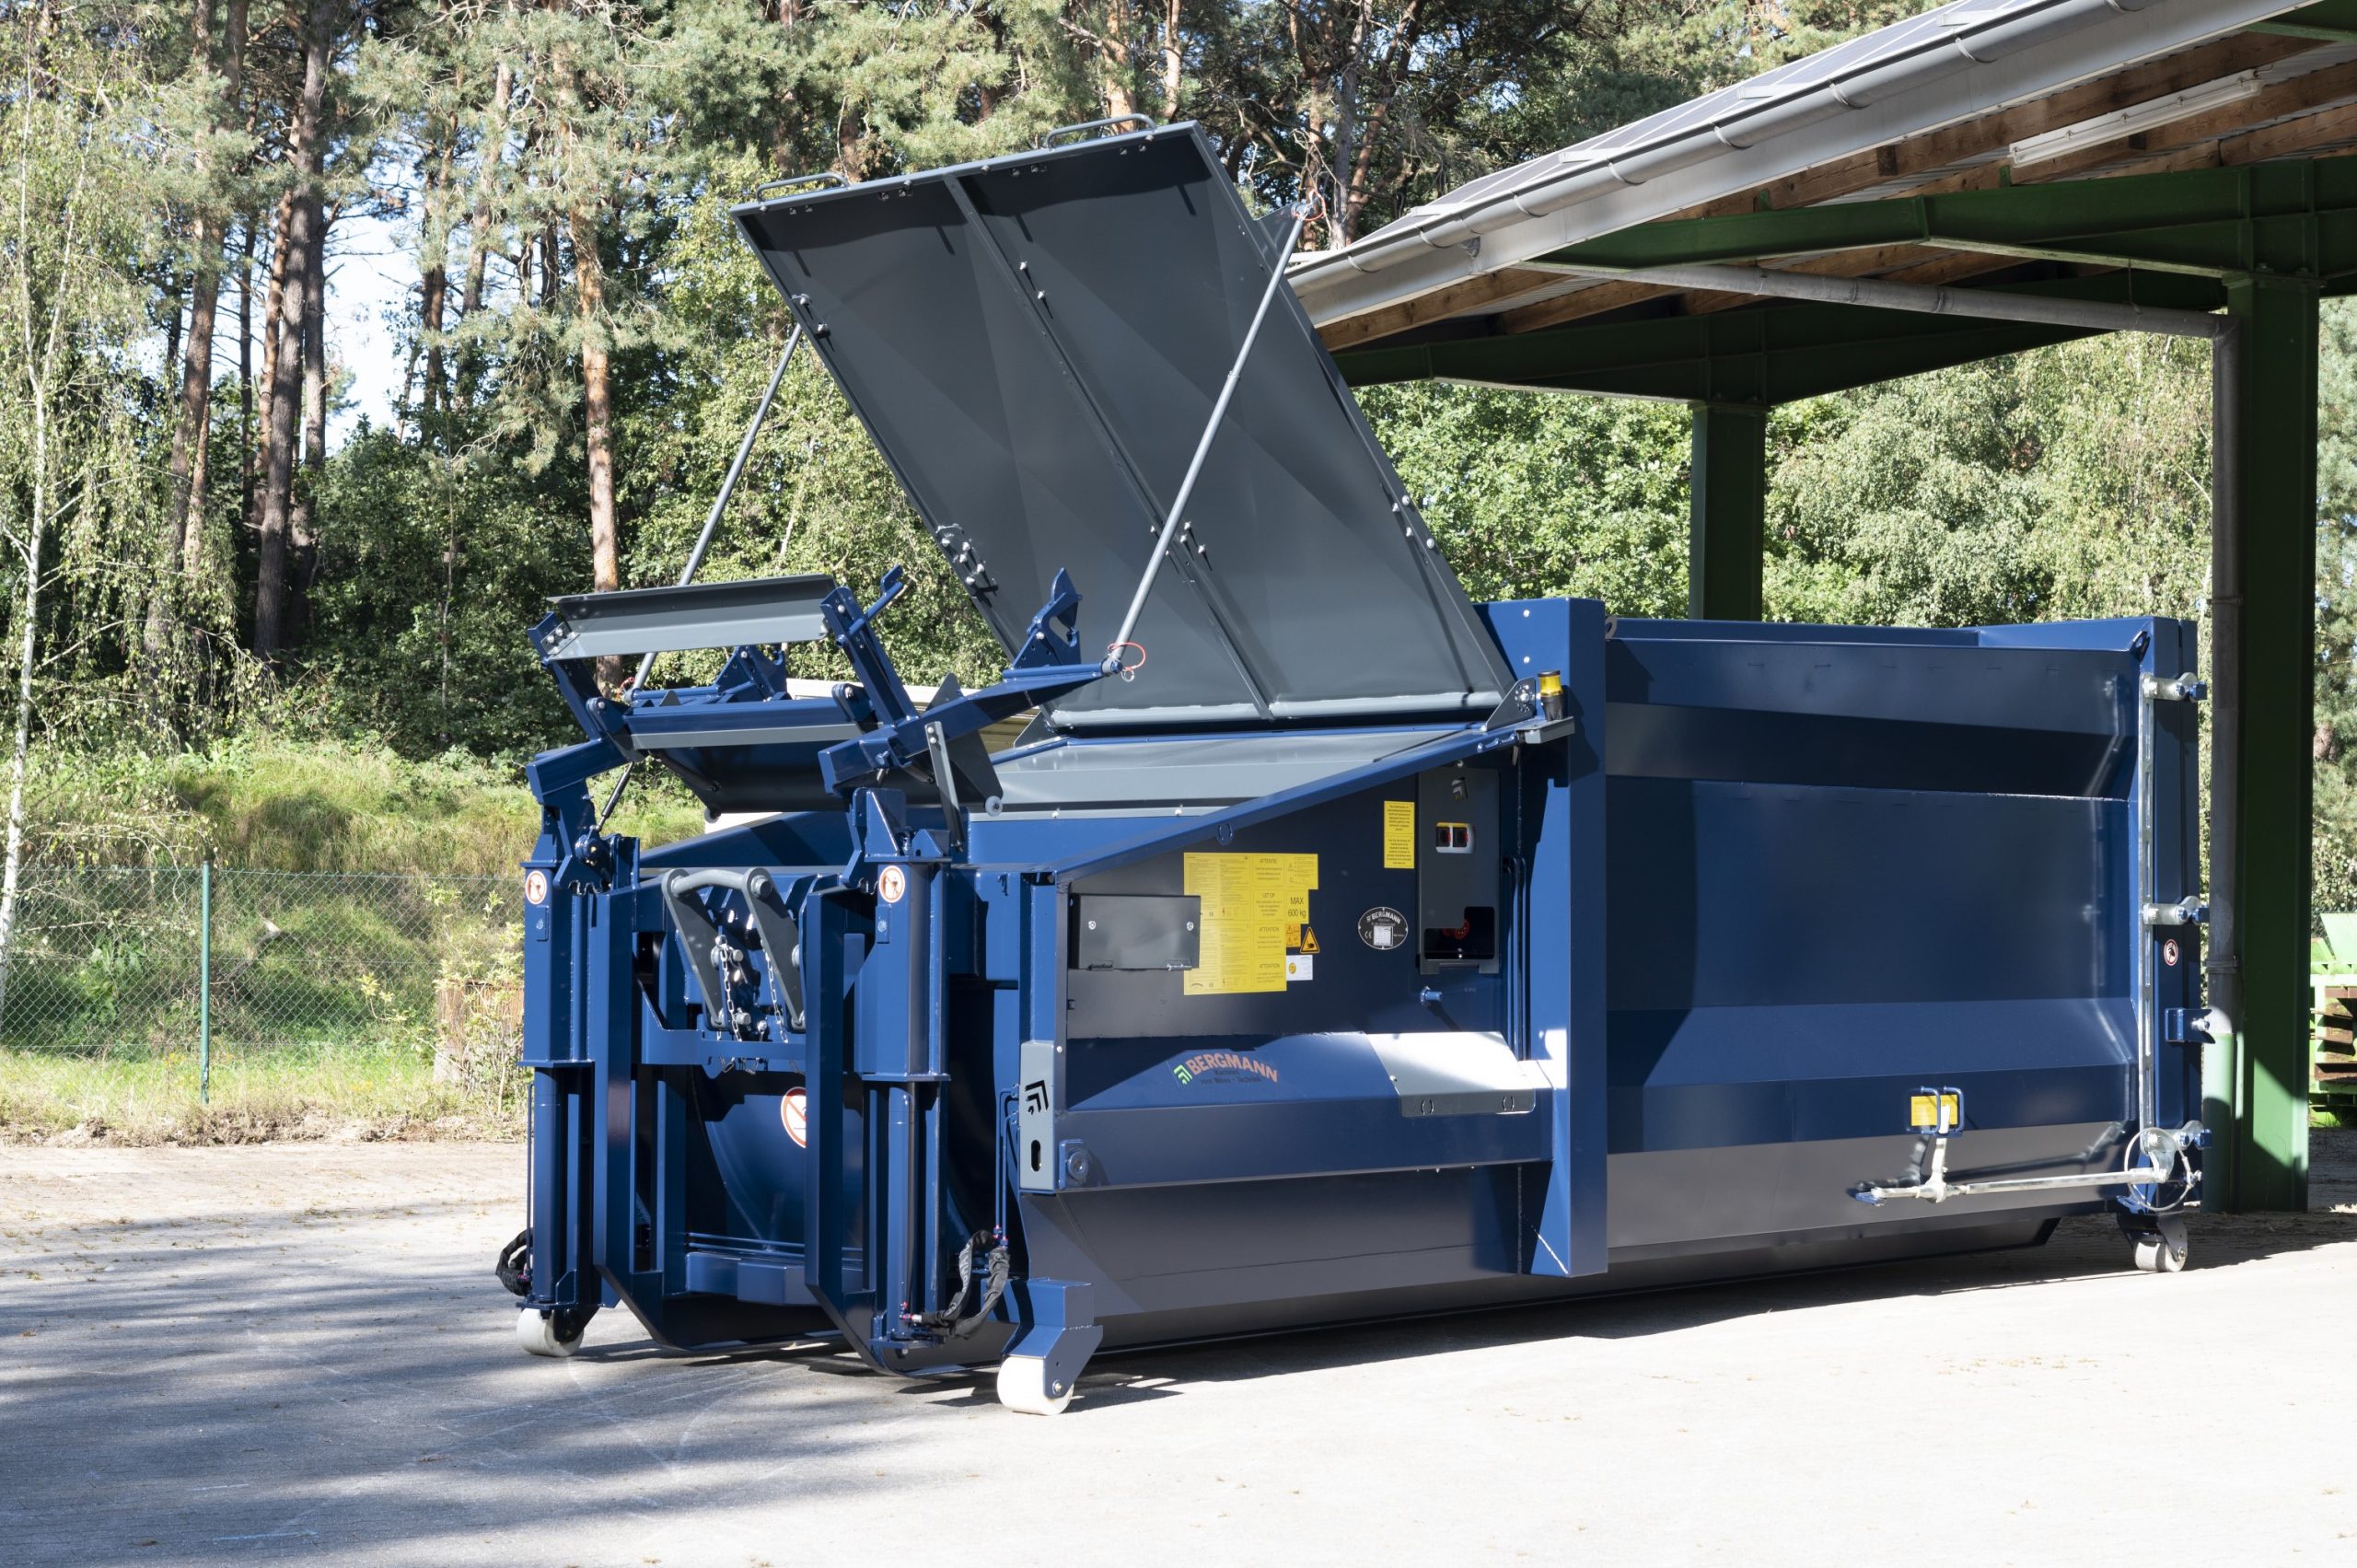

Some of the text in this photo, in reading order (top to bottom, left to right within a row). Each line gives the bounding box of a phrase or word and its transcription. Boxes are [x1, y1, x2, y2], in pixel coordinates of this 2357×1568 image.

[1290, 897, 1304, 905] MAX
[1288, 909, 1306, 919] 600 kg
[1372, 911, 1401, 924] BERGMANN
[1185, 1053, 1278, 1083] BERGMANN
